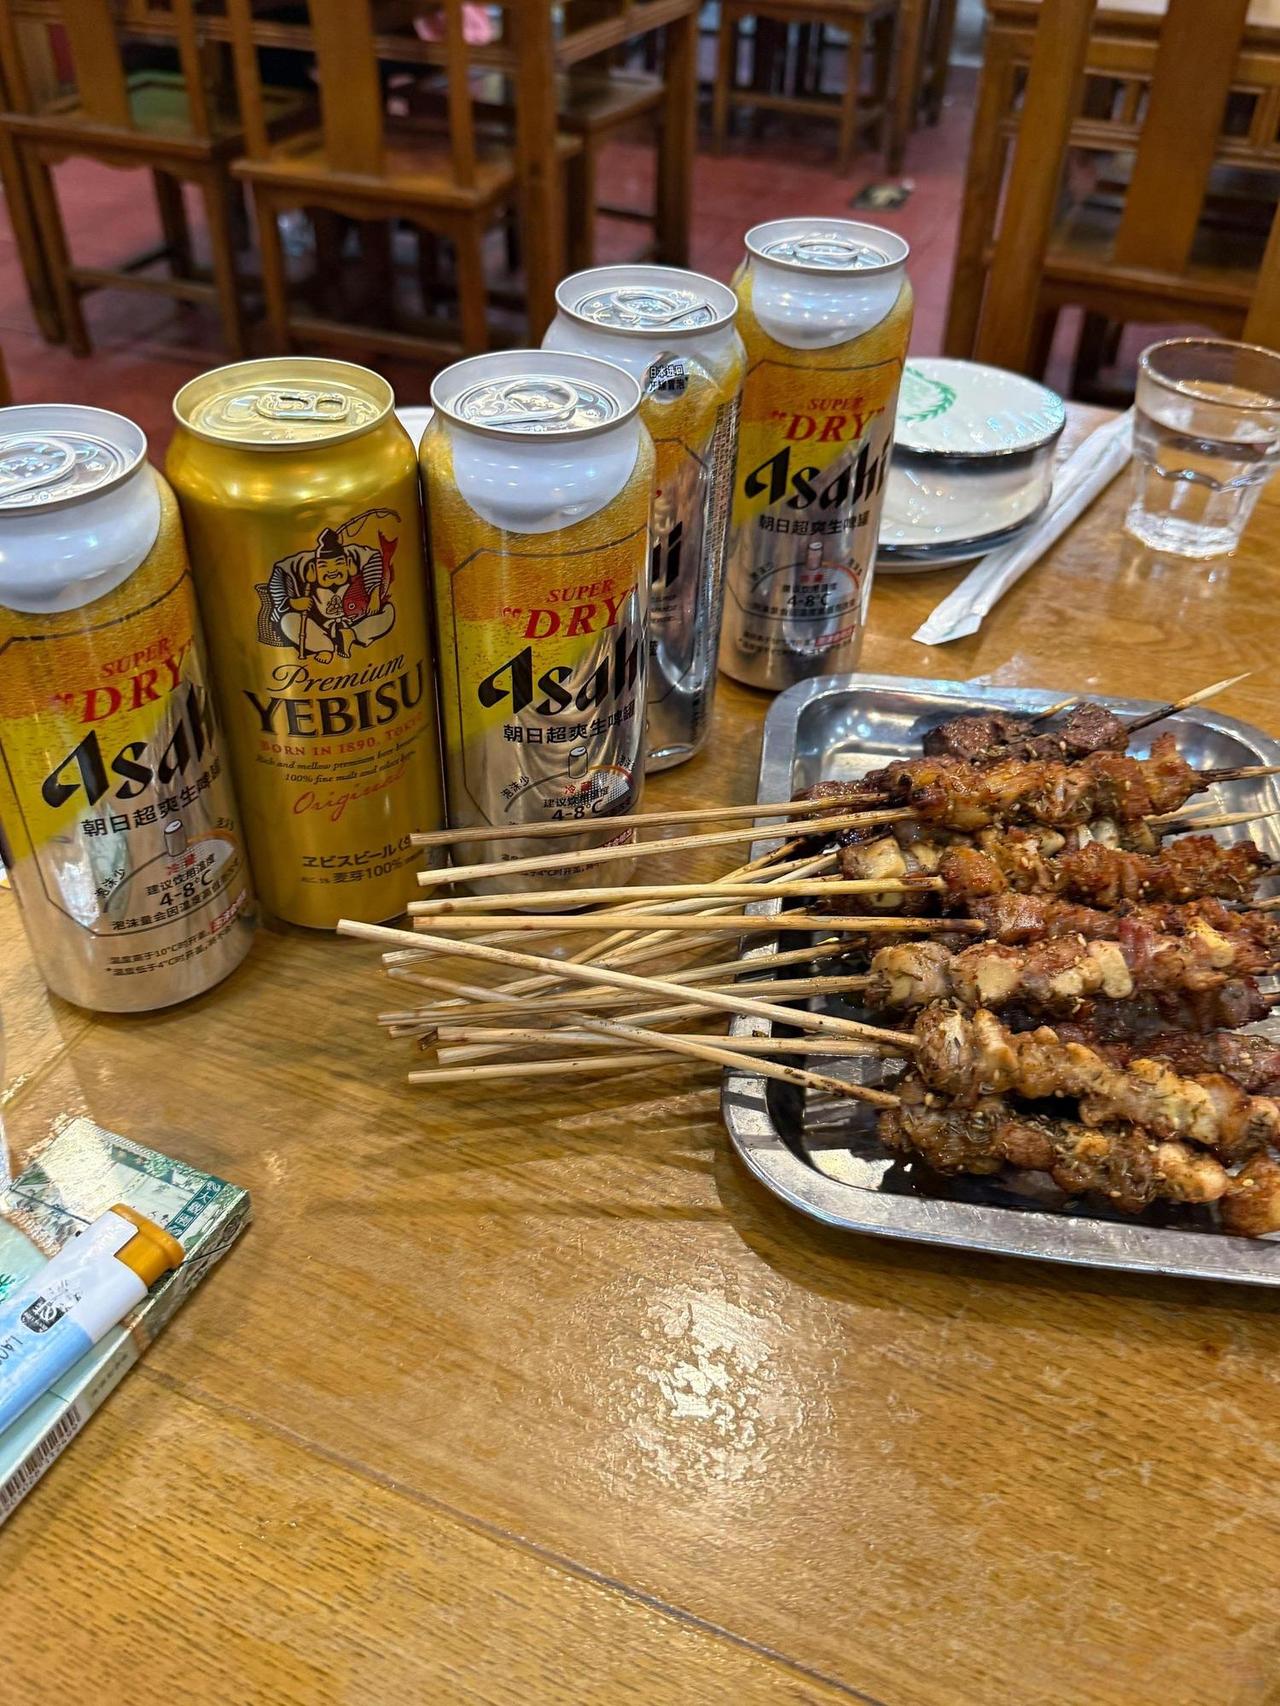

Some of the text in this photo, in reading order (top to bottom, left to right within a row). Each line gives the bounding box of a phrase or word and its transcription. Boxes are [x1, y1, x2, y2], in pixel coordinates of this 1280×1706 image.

[745, 433, 893, 511] Asahi
[548, 578, 614, 604] SUPER
[101, 637, 172, 678] SUPER
[266, 653, 405, 693] Premium
[241, 659, 425, 738] YEBISU
[260, 740, 306, 757] BORN
[313, 742, 332, 757] IN
[284, 773, 313, 784] 100%
